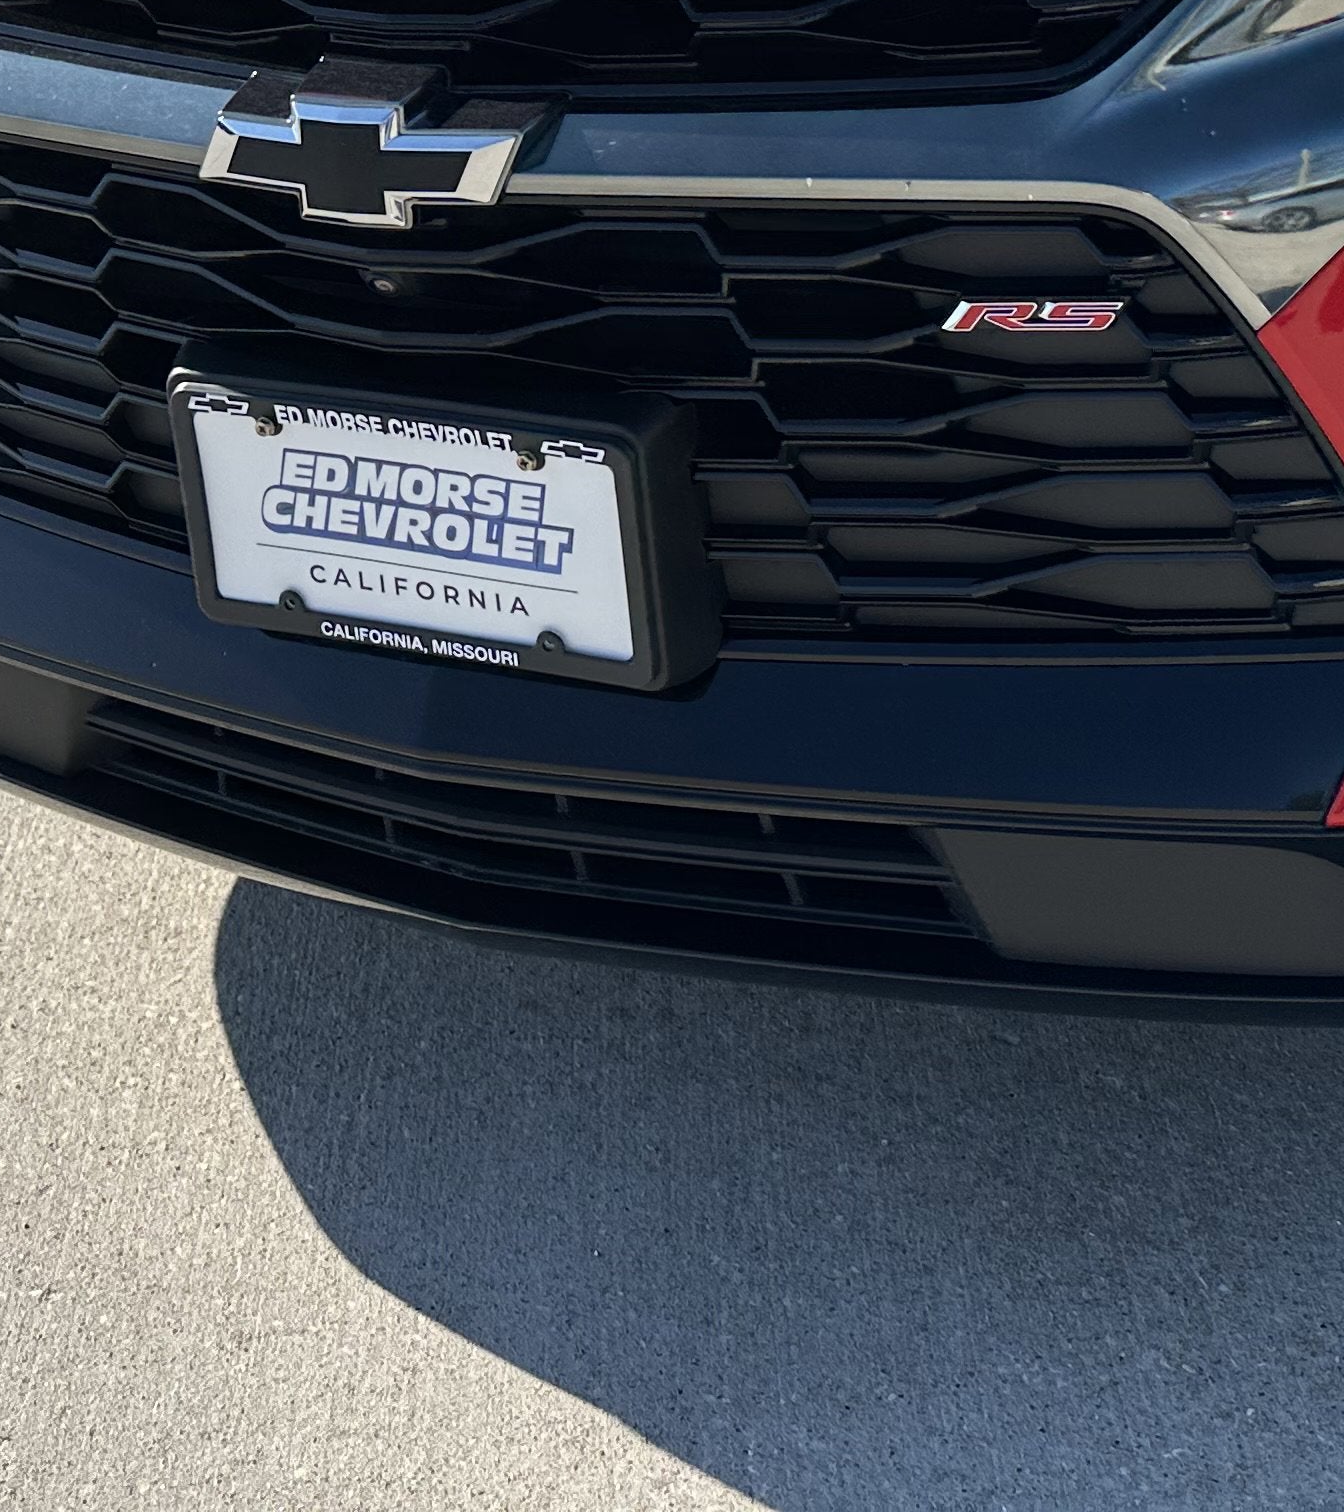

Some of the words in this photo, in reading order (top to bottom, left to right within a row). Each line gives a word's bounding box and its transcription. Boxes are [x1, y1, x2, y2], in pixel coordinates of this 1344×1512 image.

[942, 300, 1124, 332] RS
[273, 404, 305, 426] ED
[306, 408, 383, 435] MORSE
[387, 418, 513, 452] CHEVROLET
[280, 448, 354, 494] ED
[354, 456, 546, 524] MORSE
[262, 484, 574, 575] CHEVROLET
[309, 564, 530, 617] CALIFORNIA
[320, 620, 429, 655] CALIFORNIA,
[432, 638, 520, 667] MISSOURI
